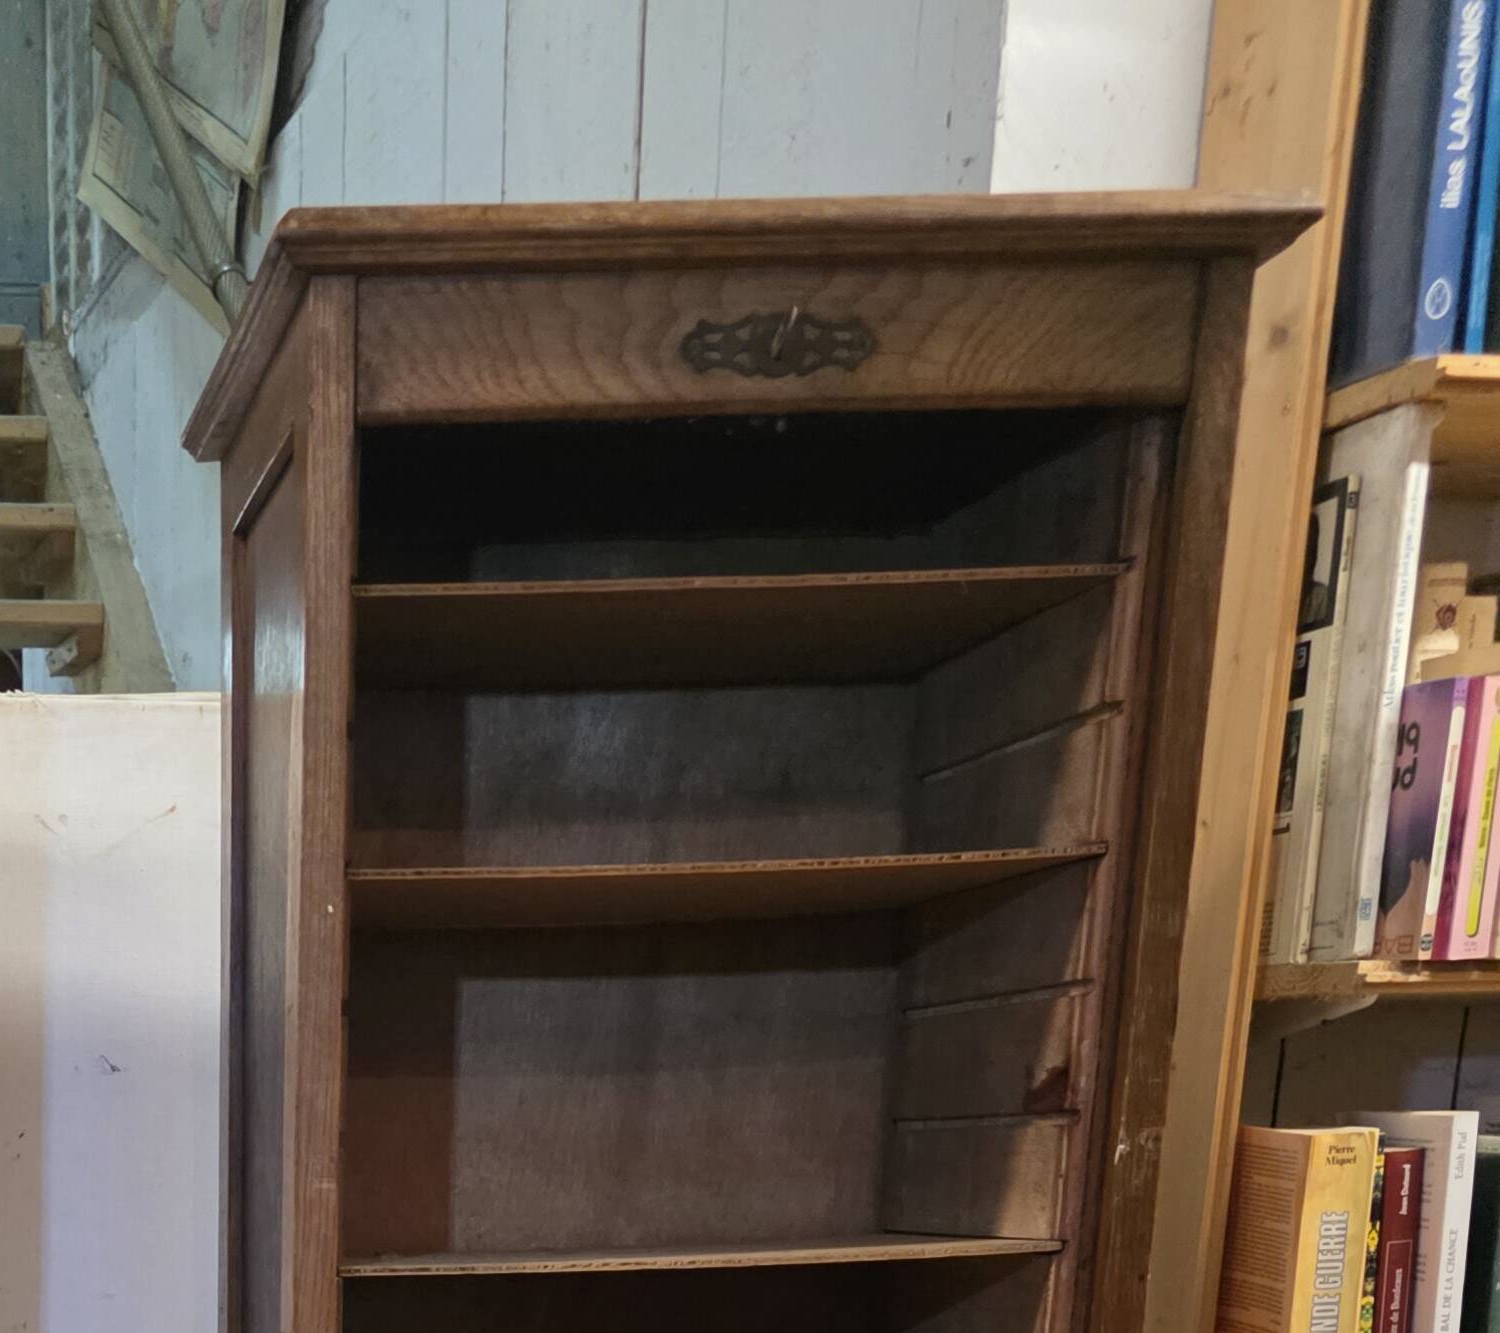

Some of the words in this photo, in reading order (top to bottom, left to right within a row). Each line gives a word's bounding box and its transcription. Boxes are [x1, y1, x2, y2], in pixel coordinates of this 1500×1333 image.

[1328, 1145, 1356, 1155] Pierre
[1314, 1210, 1349, 1290] GUERRE
[1445, 1228, 1458, 1274] CHANCE
[1443, 1275, 1454, 1291] LA
[1442, 1293, 1453, 1309] DE
[1389, 1311, 1400, 1323] de
[1440, 1312, 1451, 1332] BAL
